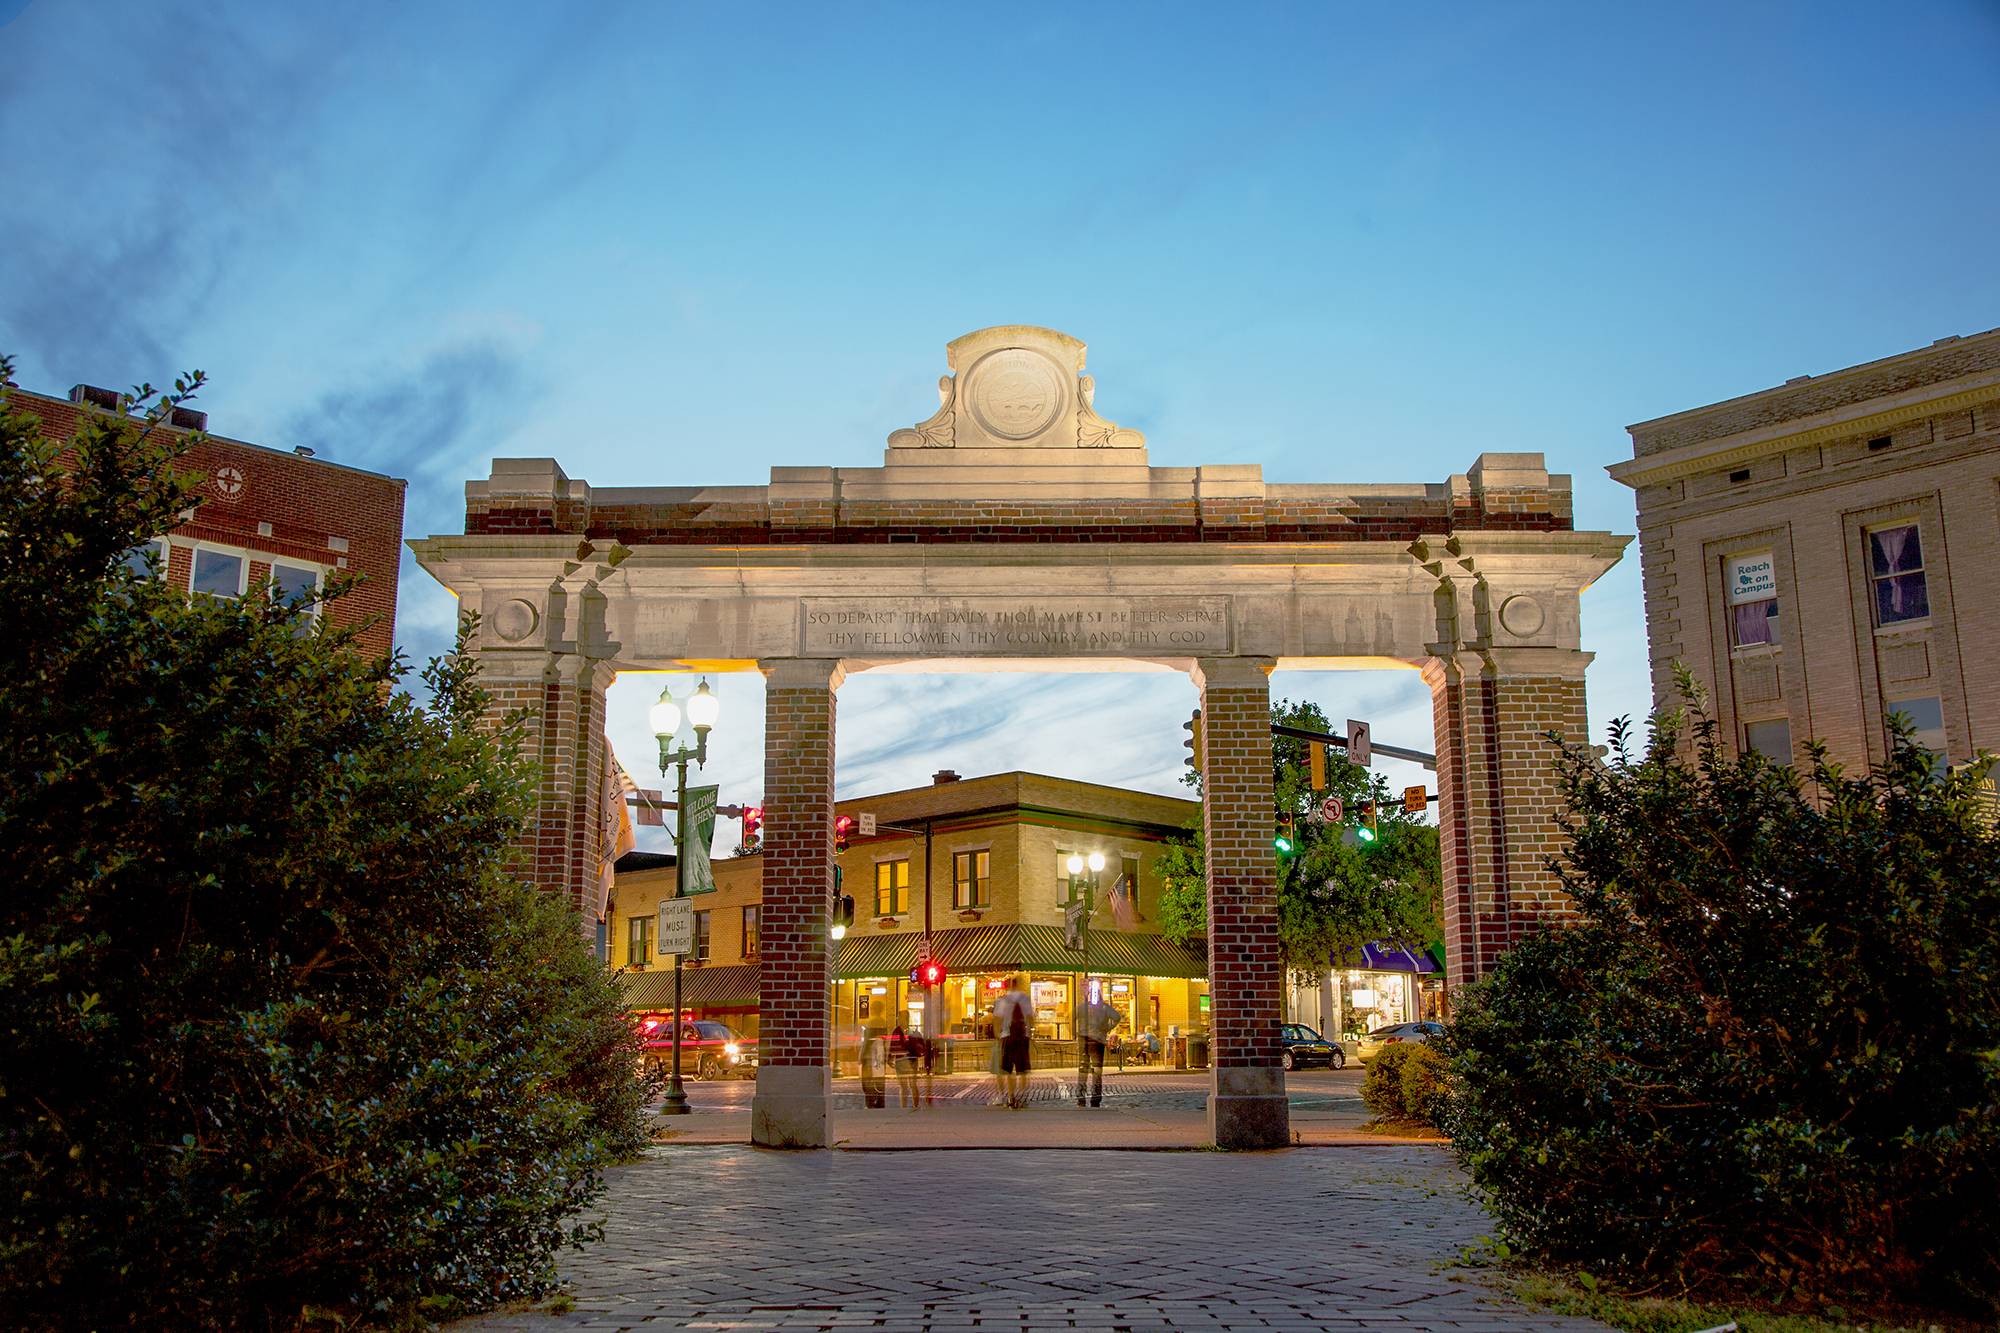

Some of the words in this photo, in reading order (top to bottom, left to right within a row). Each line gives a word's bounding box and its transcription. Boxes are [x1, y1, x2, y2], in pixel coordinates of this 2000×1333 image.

[1738, 562, 1770, 575] Reach
[1734, 582, 1775, 594] Campus
[807, 612, 831, 625] SO
[836, 611, 896, 625] DEPART
[903, 611, 938, 624] THAT
[945, 611, 986, 624] DAILY
[1043, 610, 1103, 623] MAYEST
[1176, 610, 1225, 623] SERVE
[826, 632, 857, 645] THY
[864, 632, 961, 645] FELLOWMEN
[968, 631, 1001, 644] THY
[1006, 631, 1081, 644] COUNTRY
[1088, 631, 1123, 643] AND
[1130, 631, 1162, 643] THY
[1168, 630, 1207, 643] GOD
[1352, 752, 1368, 762] ONLY
[677, 904, 690, 914] LANE
[666, 920, 684, 931] MUST
[674, 936, 690, 946] RIGHT
